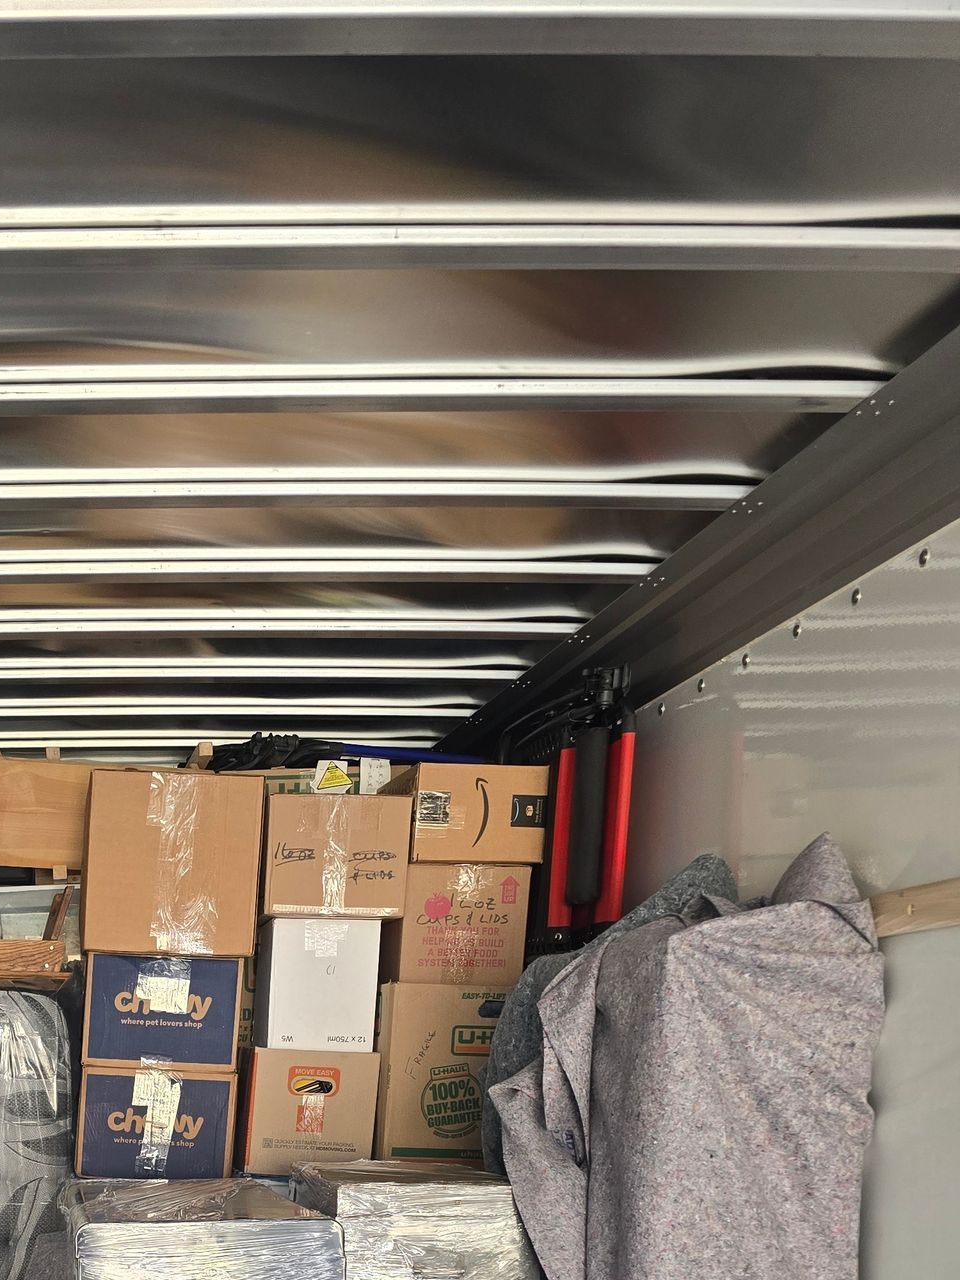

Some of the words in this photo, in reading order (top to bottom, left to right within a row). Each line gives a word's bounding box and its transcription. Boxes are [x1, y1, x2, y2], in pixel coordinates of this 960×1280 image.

[427, 926, 456, 935] THANK
[482, 927, 500, 936] FOR
[479, 939, 504, 948] BUILD
[474, 949, 498, 958] FOOD
[114, 990, 213, 1021] chy
[120, 1018, 144, 1026] where
[145, 1019, 158, 1027] pet
[160, 1019, 183, 1028] lovers
[184, 1020, 203, 1029] shop
[327, 1035, 349, 1043] 750ml
[357, 1035, 366, 1043] 12
[433, 1065, 467, 1076] U-HAUL
[429, 1079, 475, 1101] 100%
[426, 1097, 481, 1116] BUY-BACK
[107, 1108, 205, 1140] chwy
[427, 1111, 482, 1128] GUARANTEE
[113, 1136, 136, 1144] where
[176, 1139, 195, 1148] shop
